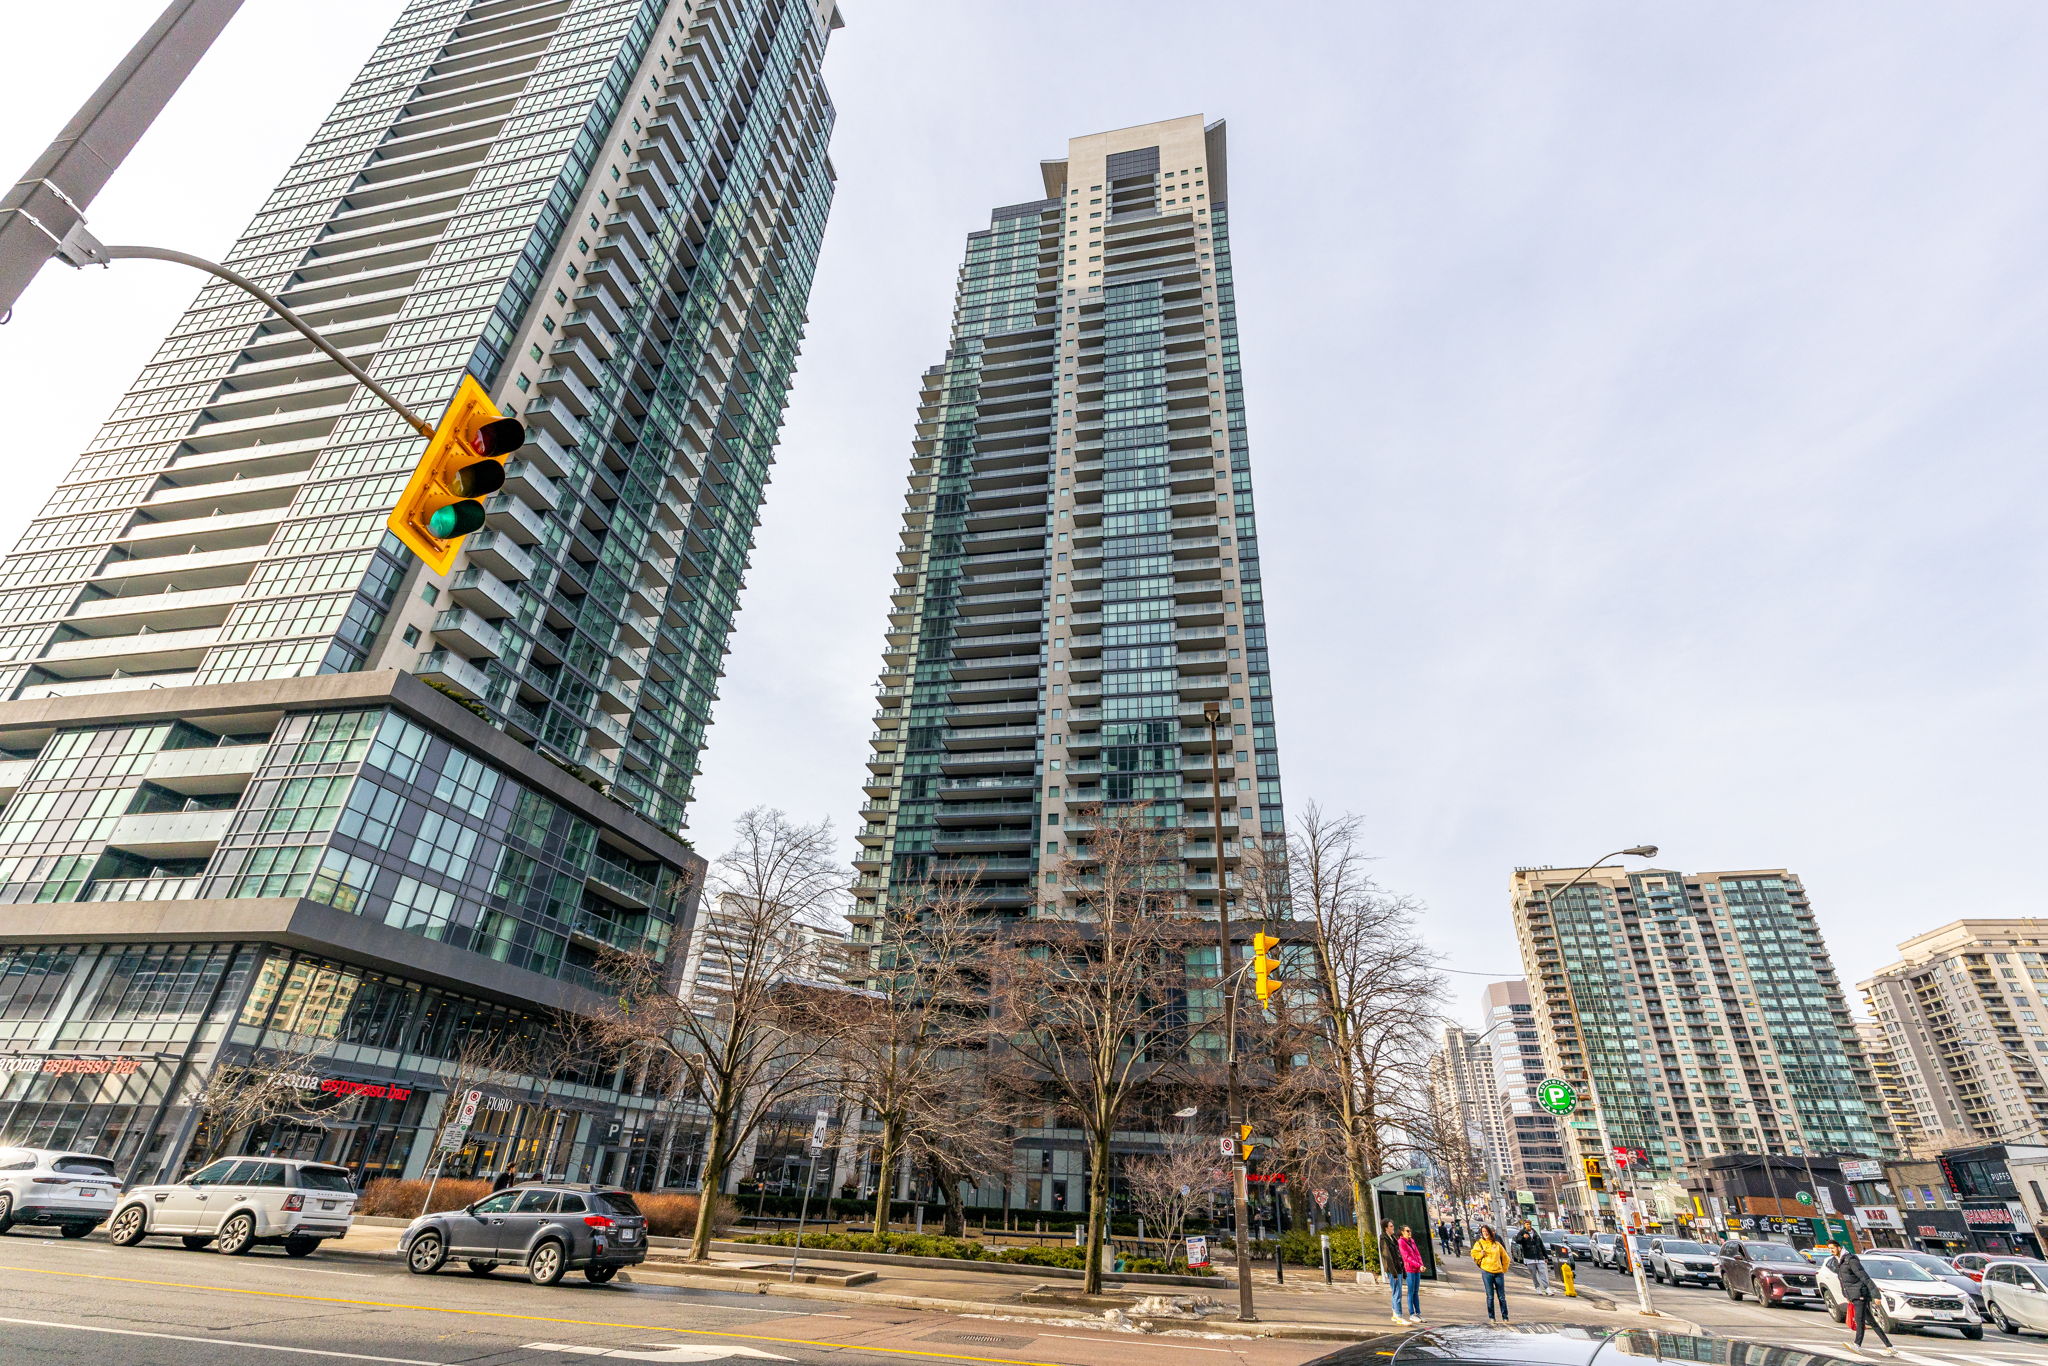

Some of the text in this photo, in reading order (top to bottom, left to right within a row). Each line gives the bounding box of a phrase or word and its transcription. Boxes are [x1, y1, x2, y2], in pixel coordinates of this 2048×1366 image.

[43, 1058, 112, 1077] espresso
[111, 1057, 141, 1074] bar
[320, 1079, 385, 1098] espresso
[386, 1083, 411, 1100] bar
[1540, 1080, 1572, 1093] MUNICIPAL
[1548, 1088, 1564, 1102] P
[486, 1096, 513, 1112] FIORIO
[1541, 1099, 1575, 1114] PARKING
[608, 1123, 620, 1137] P
[814, 1127, 825, 1144] 40
[1990, 1172, 2011, 1181] PUFFS
[1962, 1208, 2014, 1224] SHAWARMA
